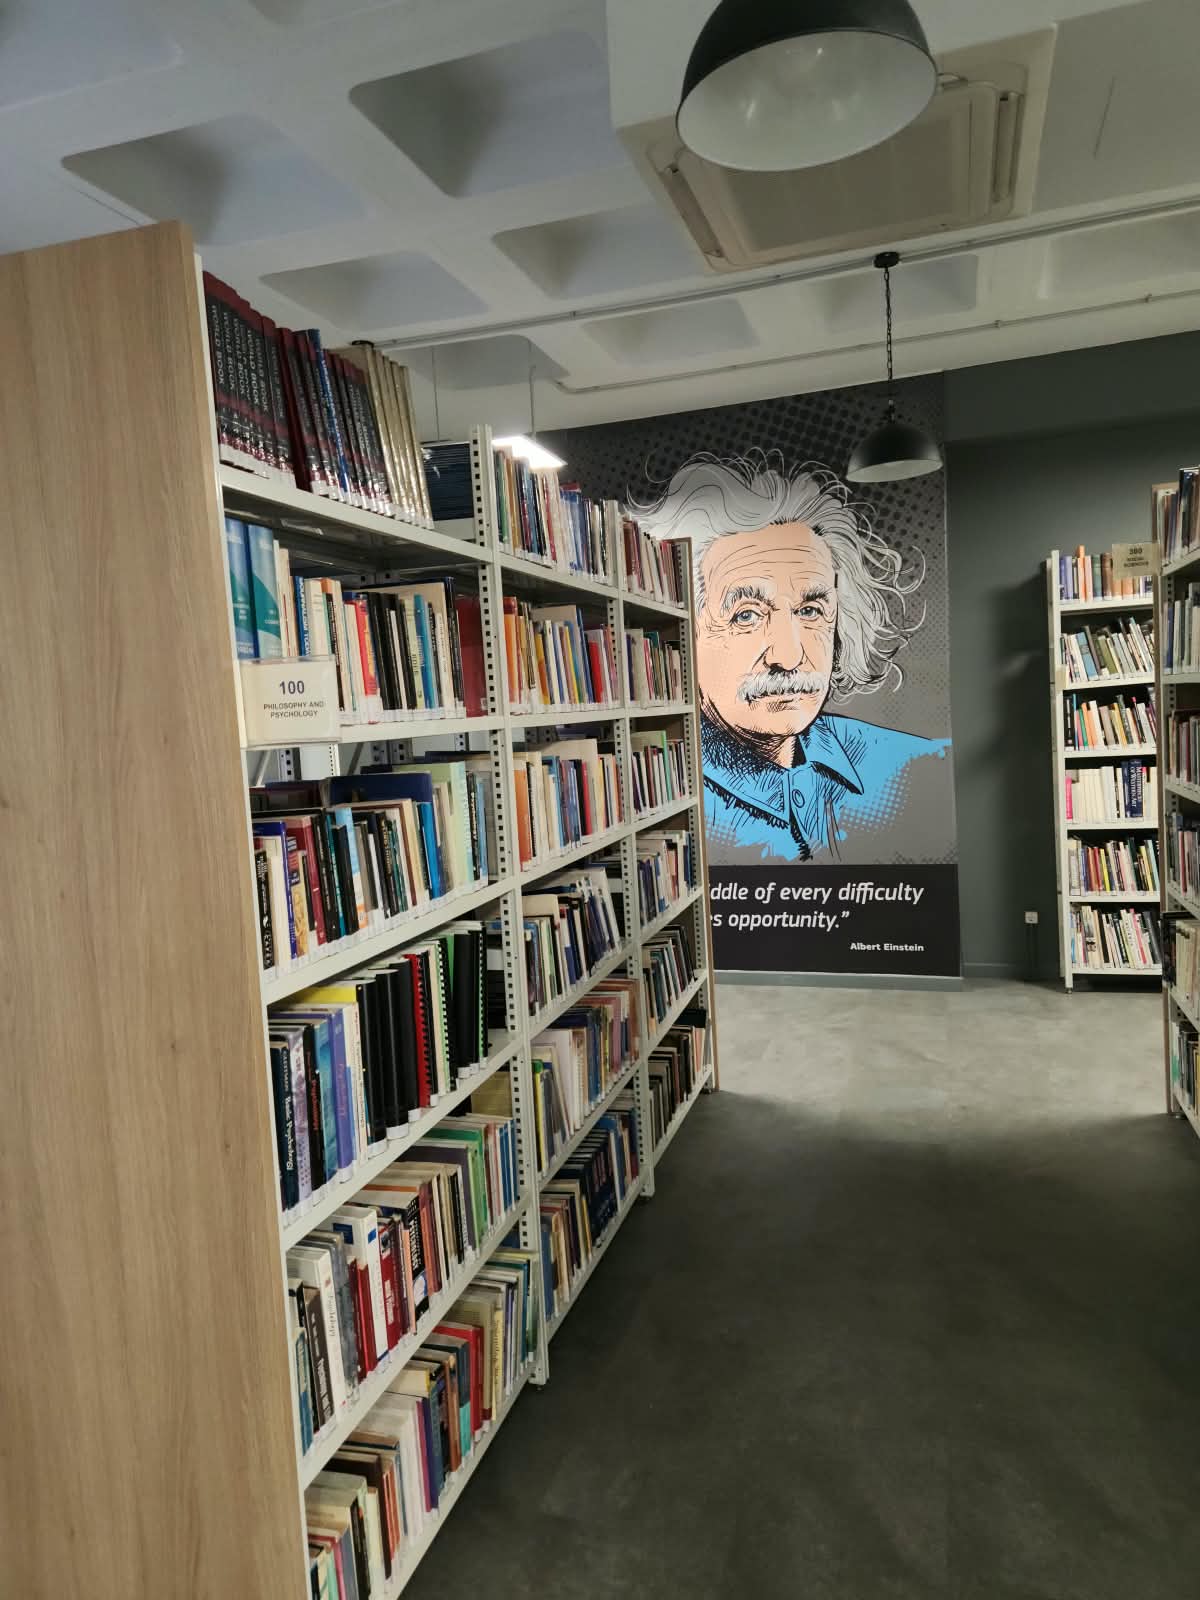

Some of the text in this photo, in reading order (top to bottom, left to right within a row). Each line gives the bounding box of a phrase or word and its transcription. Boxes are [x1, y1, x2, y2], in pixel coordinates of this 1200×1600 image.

[279, 680, 305, 695] 100
[263, 700, 325, 710] PHILOSOPHY AND
[270, 710, 319, 719] PSYCHOLOGY
[709, 881, 924, 905] ddle of every difficulty
[850, 942, 925, 952] Albert Einstein
